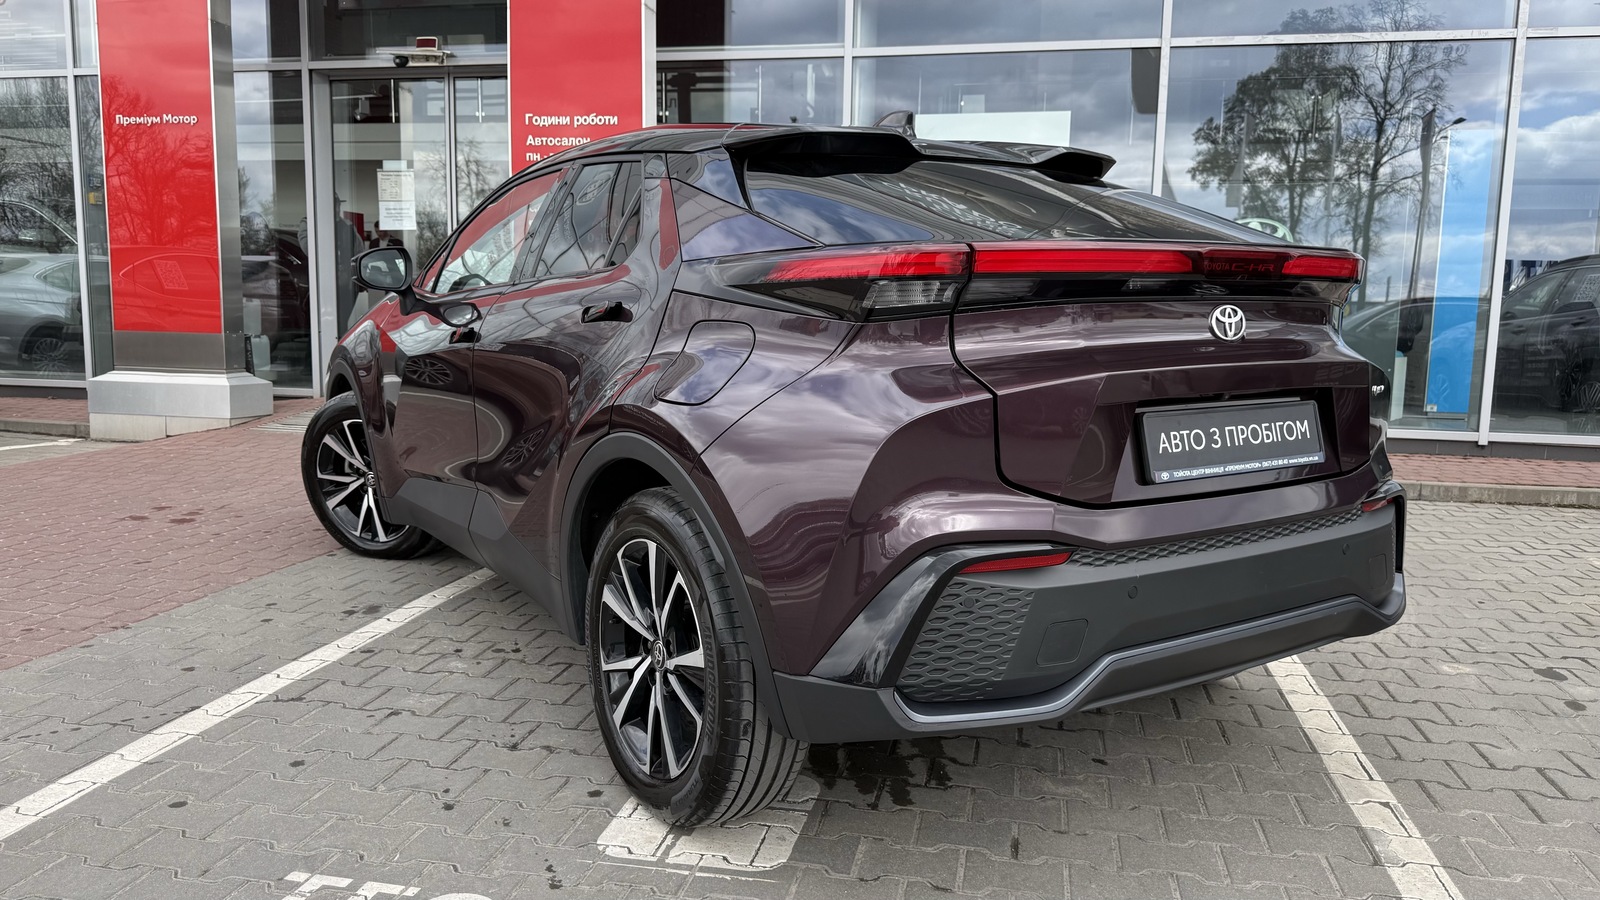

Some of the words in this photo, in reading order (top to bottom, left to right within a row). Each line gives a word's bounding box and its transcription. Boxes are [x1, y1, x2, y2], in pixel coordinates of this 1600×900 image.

[115, 114, 160, 127] Преміум
[163, 113, 198, 126] Мотор
[525, 113, 570, 127] Години
[573, 113, 618, 128] роботи
[1204, 262, 1230, 271] TOYOTA
[1231, 263, 1275, 271] C-HR
[1159, 429, 1206, 454] АВТО
[1224, 419, 1310, 447] ПРОБІГОМ
